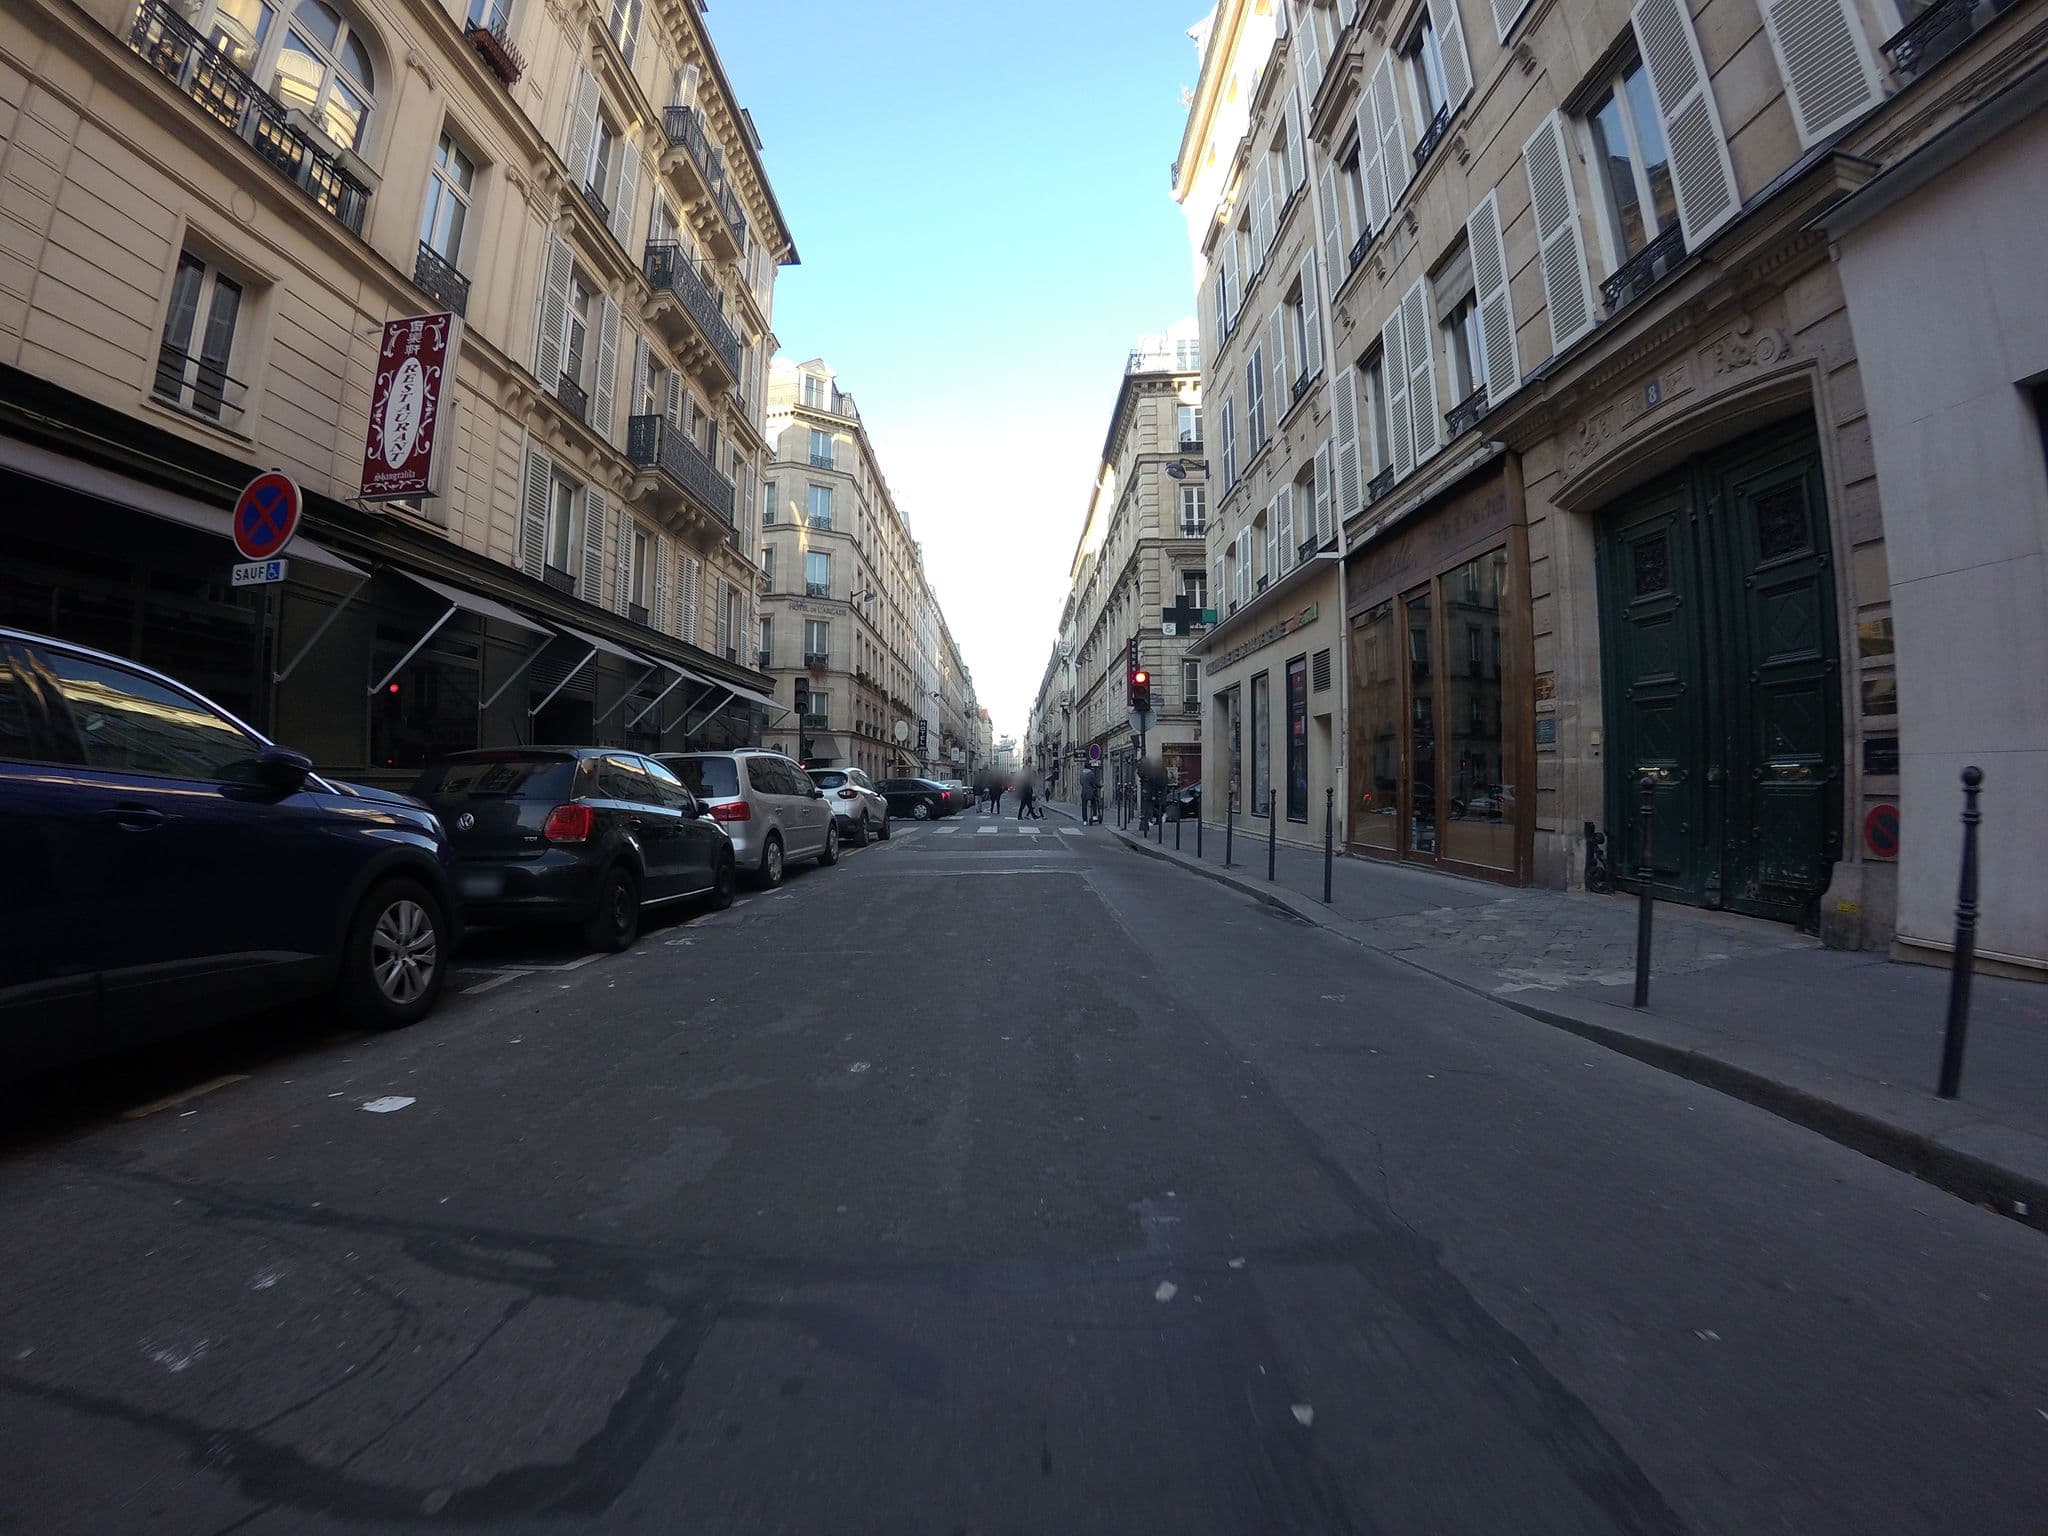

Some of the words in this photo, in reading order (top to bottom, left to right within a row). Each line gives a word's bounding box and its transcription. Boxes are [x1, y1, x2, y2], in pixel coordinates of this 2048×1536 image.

[1648, 385, 1657, 403] 8
[390, 364, 418, 461] RESTAURANT
[234, 566, 265, 581] SAUF
